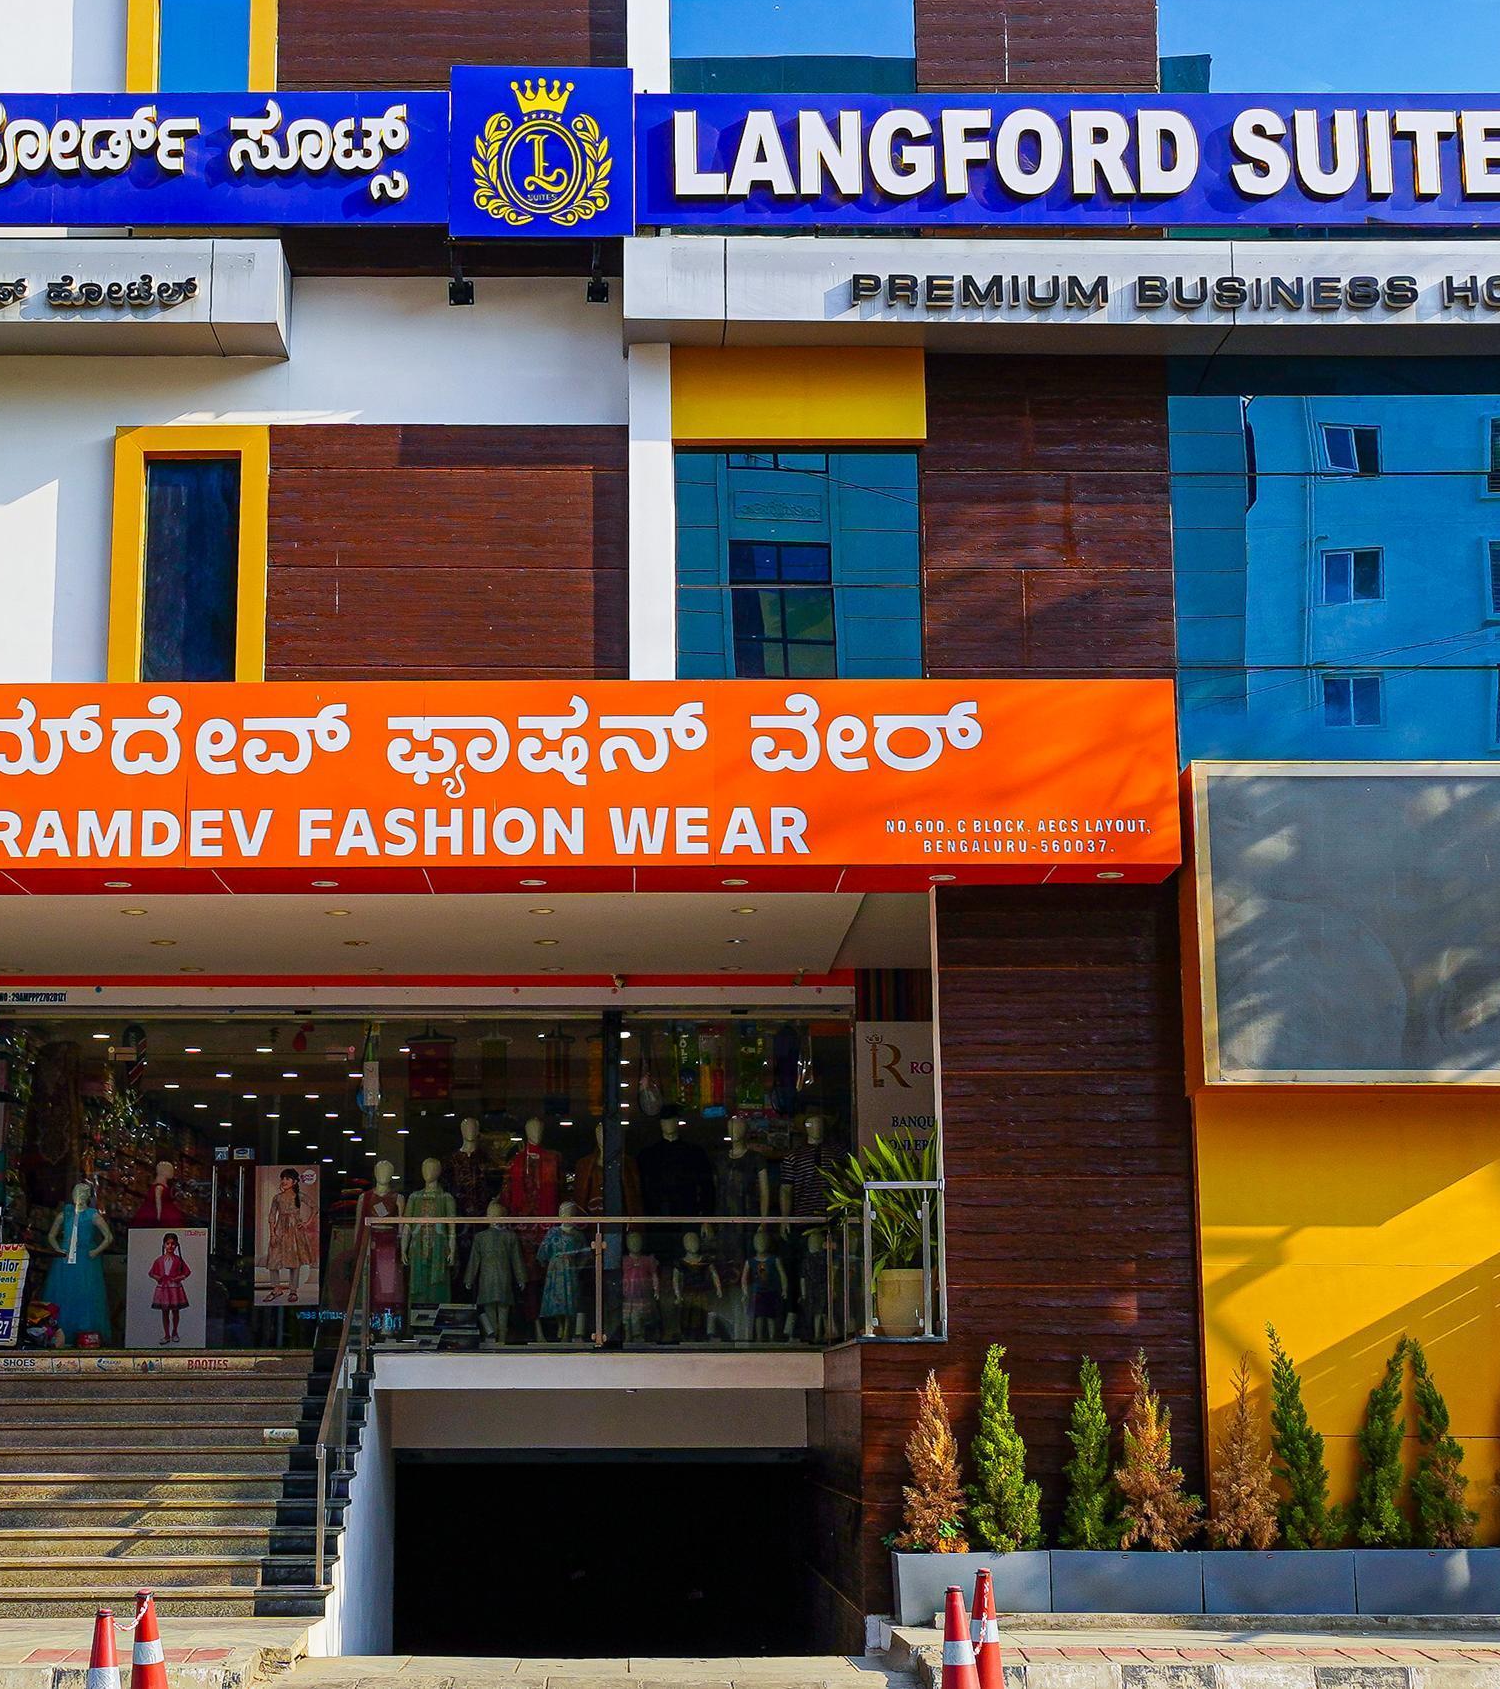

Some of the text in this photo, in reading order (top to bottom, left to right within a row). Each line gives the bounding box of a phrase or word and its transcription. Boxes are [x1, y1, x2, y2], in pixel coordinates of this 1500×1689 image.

[673, 108, 1199, 197] LANGFORD
[852, 273, 1109, 309] PREMIUM
[1135, 273, 1418, 309] BUSINESS
[299, 807, 585, 857] FASHION
[608, 806, 810, 855] WEAR
[957, 819, 967, 833] C
[1037, 819, 1079, 833] AECS
[3, 1358, 36, 1367] SHOES
